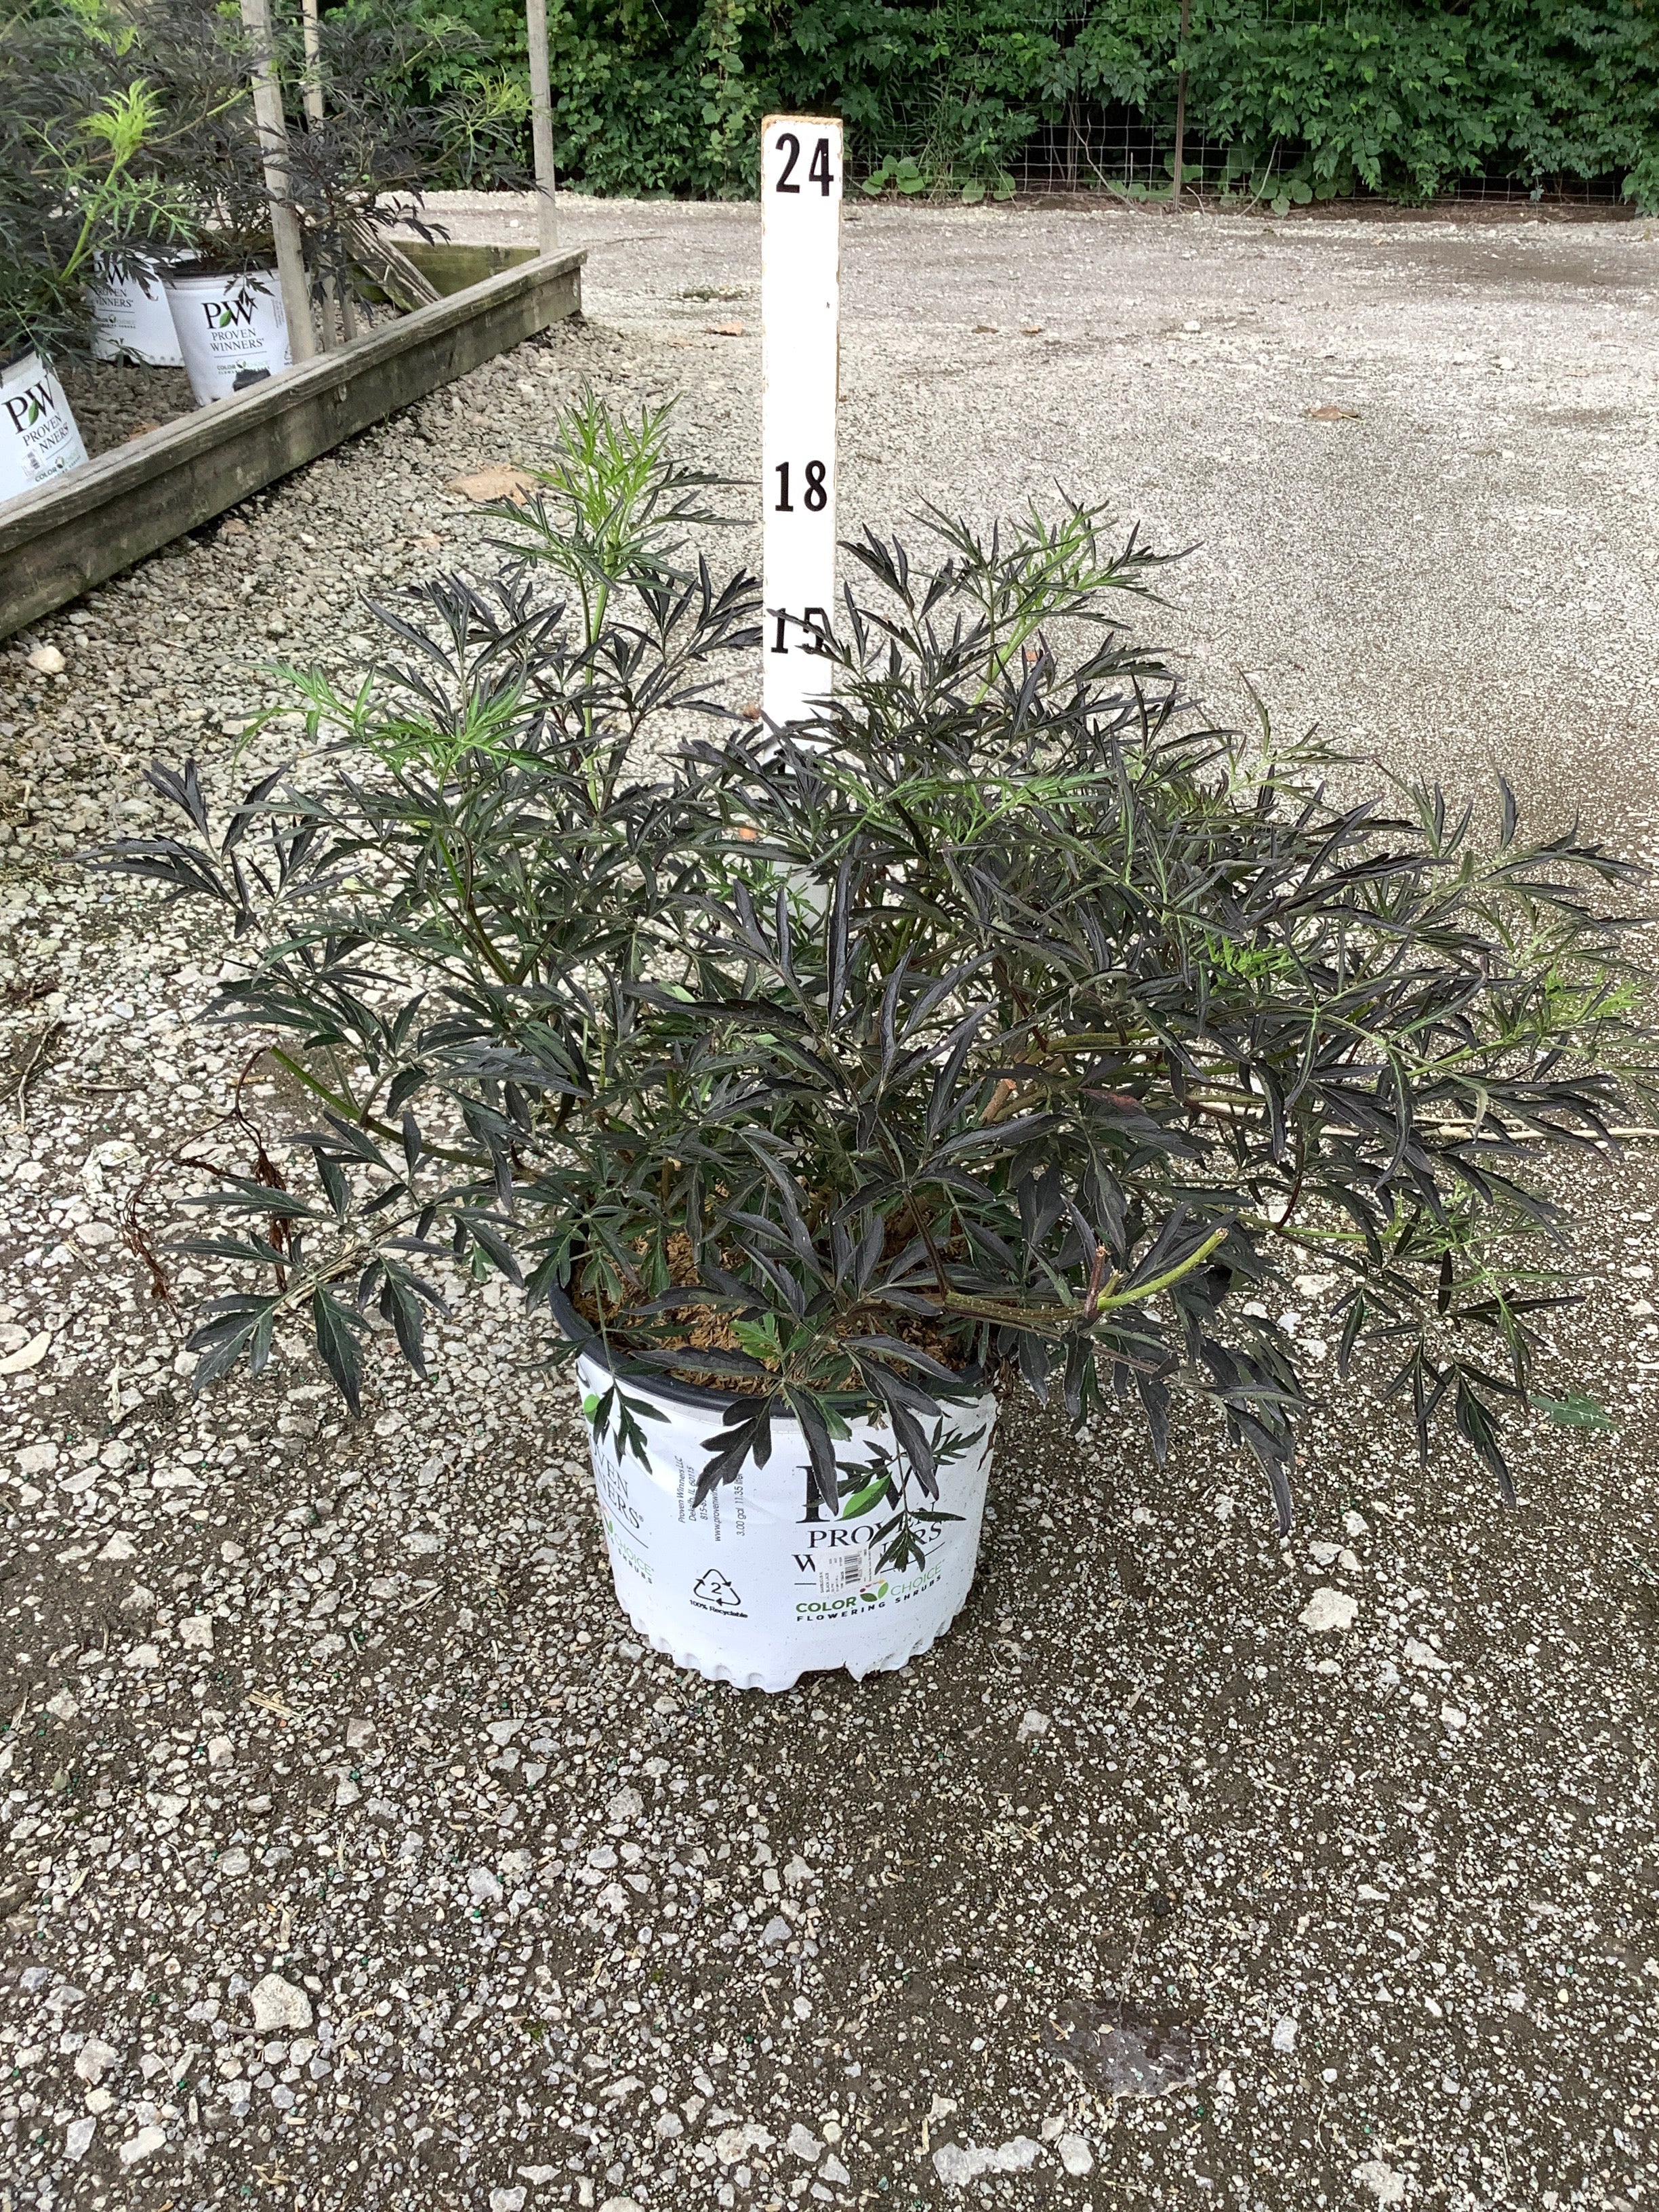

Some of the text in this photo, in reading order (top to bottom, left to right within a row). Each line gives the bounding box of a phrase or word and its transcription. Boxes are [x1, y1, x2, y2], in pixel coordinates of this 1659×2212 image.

[775, 133, 834, 197] 24
[201, 298, 256, 329] PW
[211, 328, 256, 341] PROVEN
[1, 374, 55, 434] PW
[22, 412, 62, 447] PROVEN
[39, 422, 68, 453] NNERS
[35, 467, 58, 483] COLOR
[775, 460, 827, 512] 18
[771, 607, 824, 655] 15
[674, 1456, 684, 1469] LLC
[676, 1469, 685, 1498] Winners
[686, 1465, 696, 1486] 60115
[734, 1486, 743, 1504] 11.35
[735, 1508, 746, 1519] gal
[735, 1520, 745, 1536] 3.00
[711, 1582, 722, 1595] 2
[796, 1574, 942, 1622] FLOWERING SHRUBS
[689, 1599, 748, 1618] 100% Recyclable
[796, 1596, 857, 1614] COLOR
